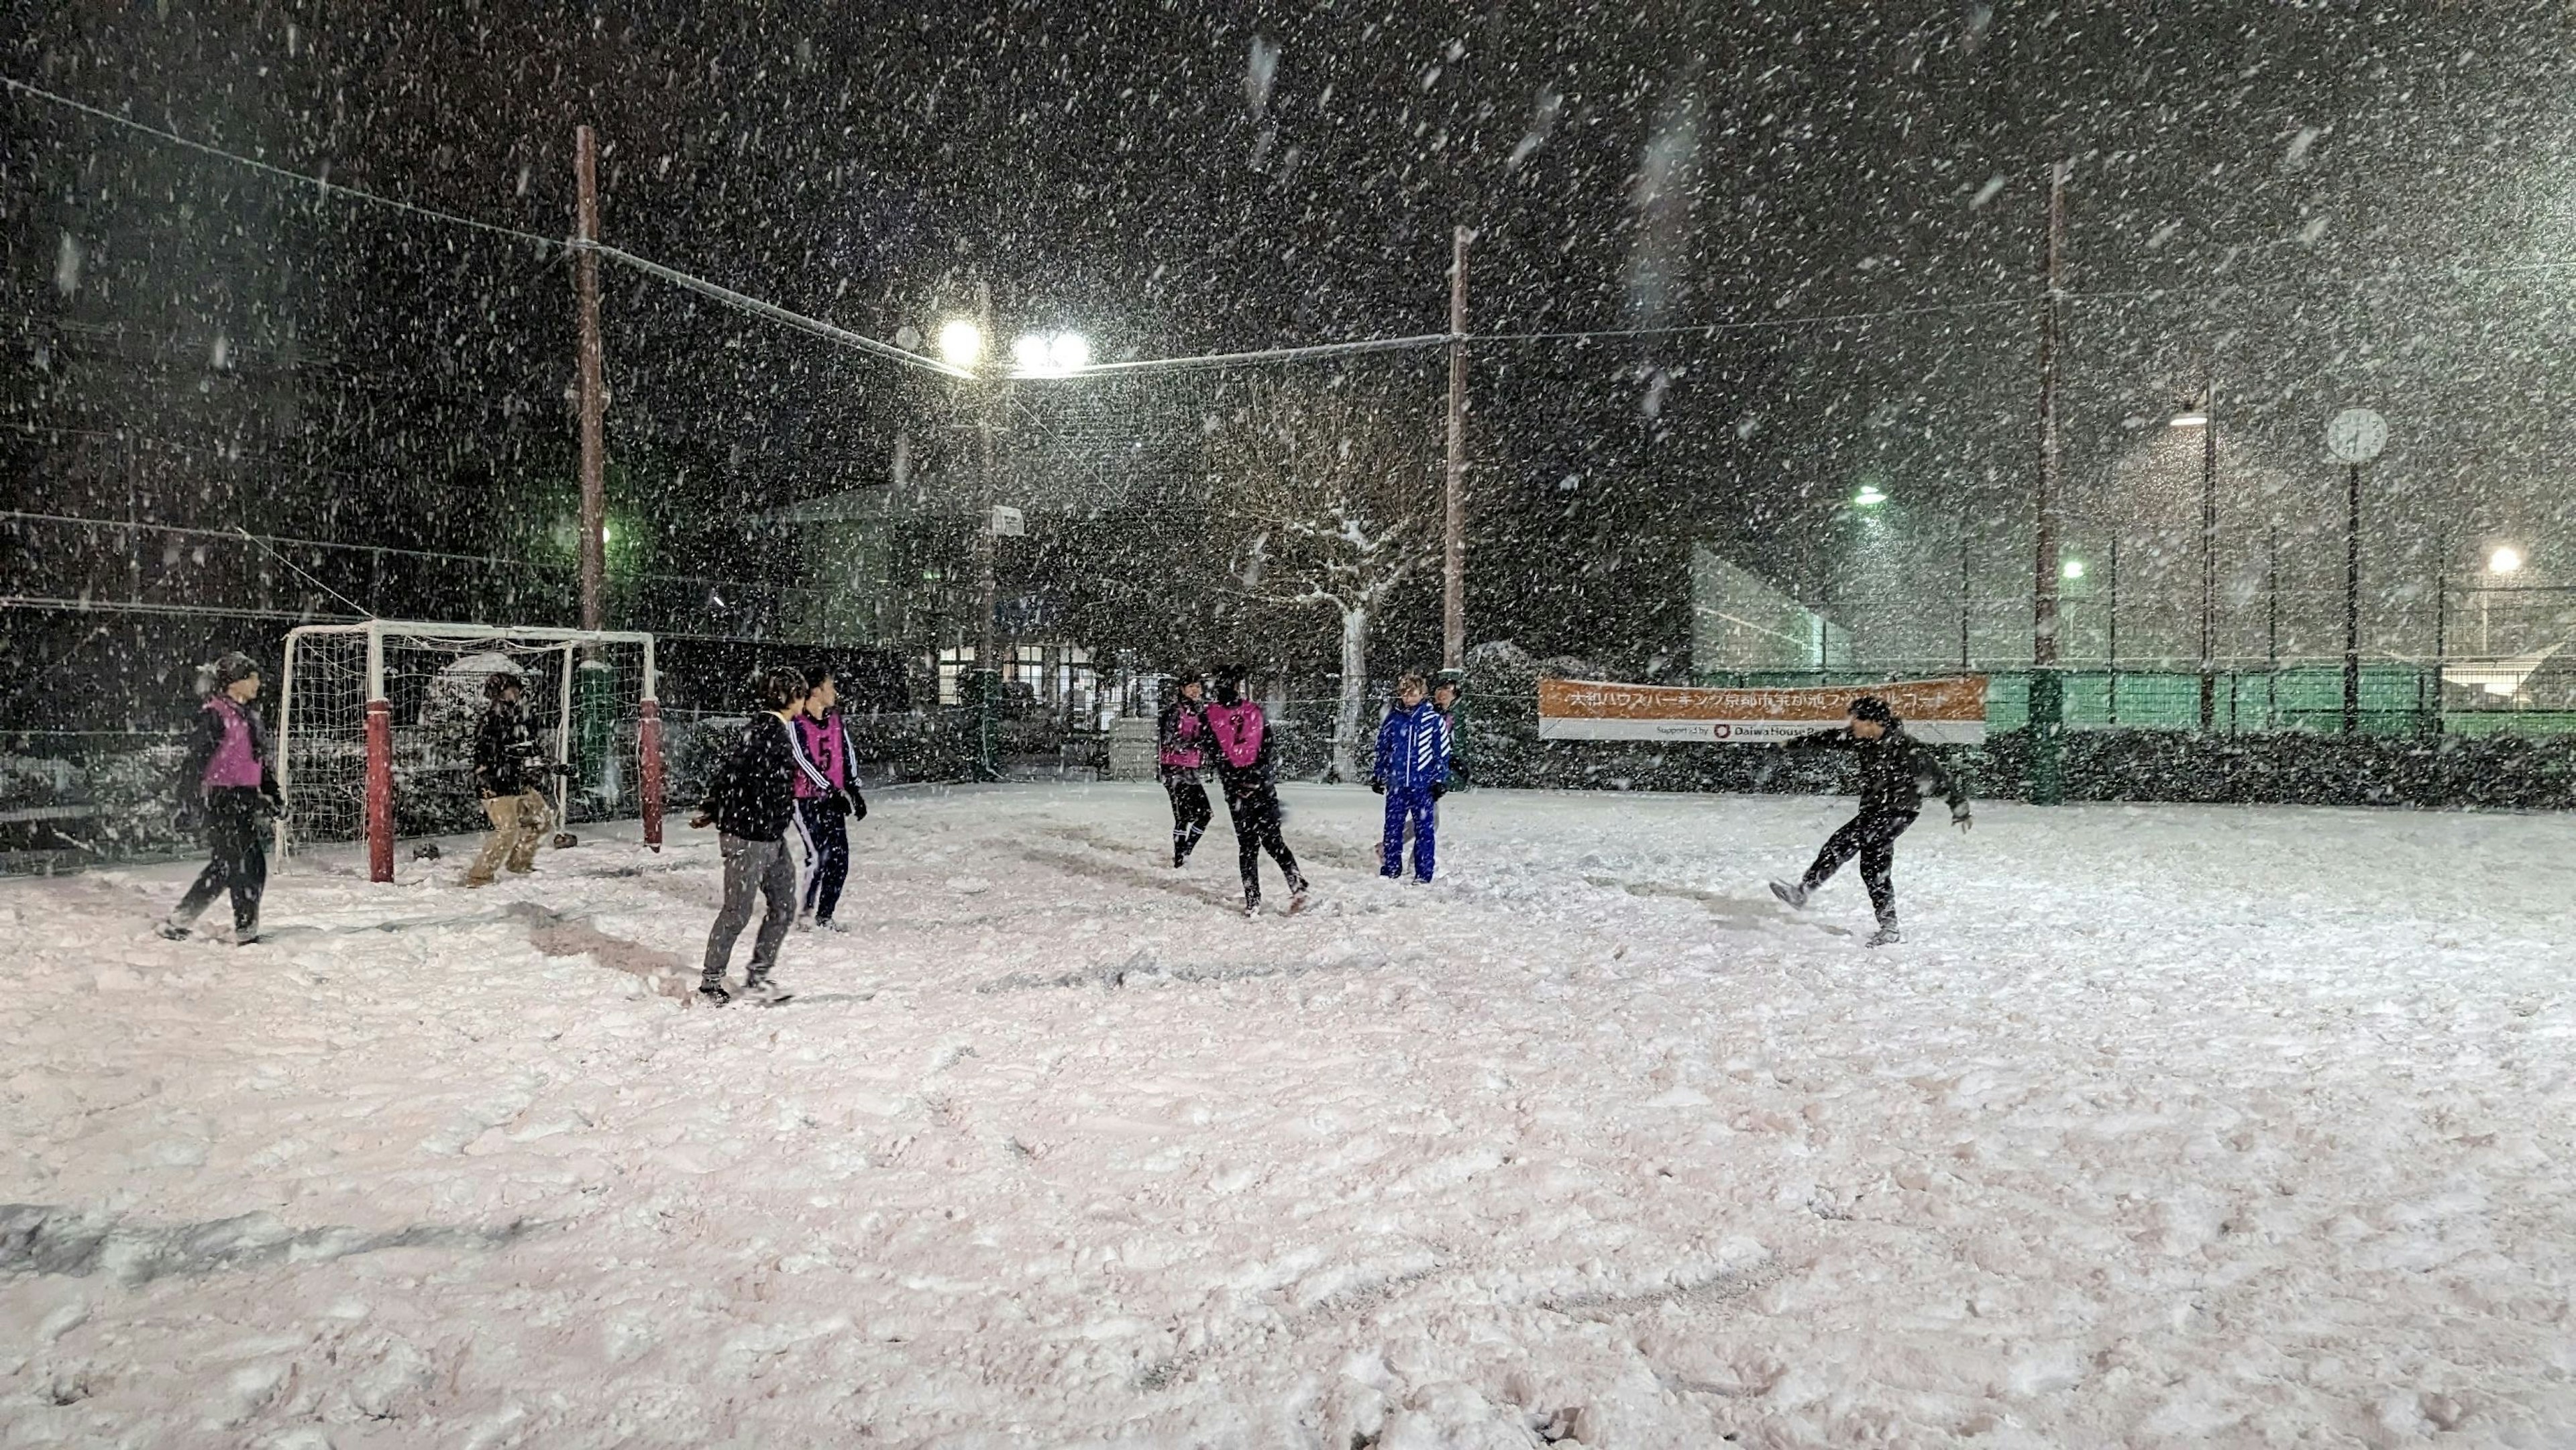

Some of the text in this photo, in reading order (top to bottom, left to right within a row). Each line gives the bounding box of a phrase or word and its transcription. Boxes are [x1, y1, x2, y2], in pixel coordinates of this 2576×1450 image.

[1699, 726, 1709, 735] by
[1735, 727, 1769, 735] Daiwa
[1771, 727, 1806, 736] House
[818, 737, 831, 771] 5
